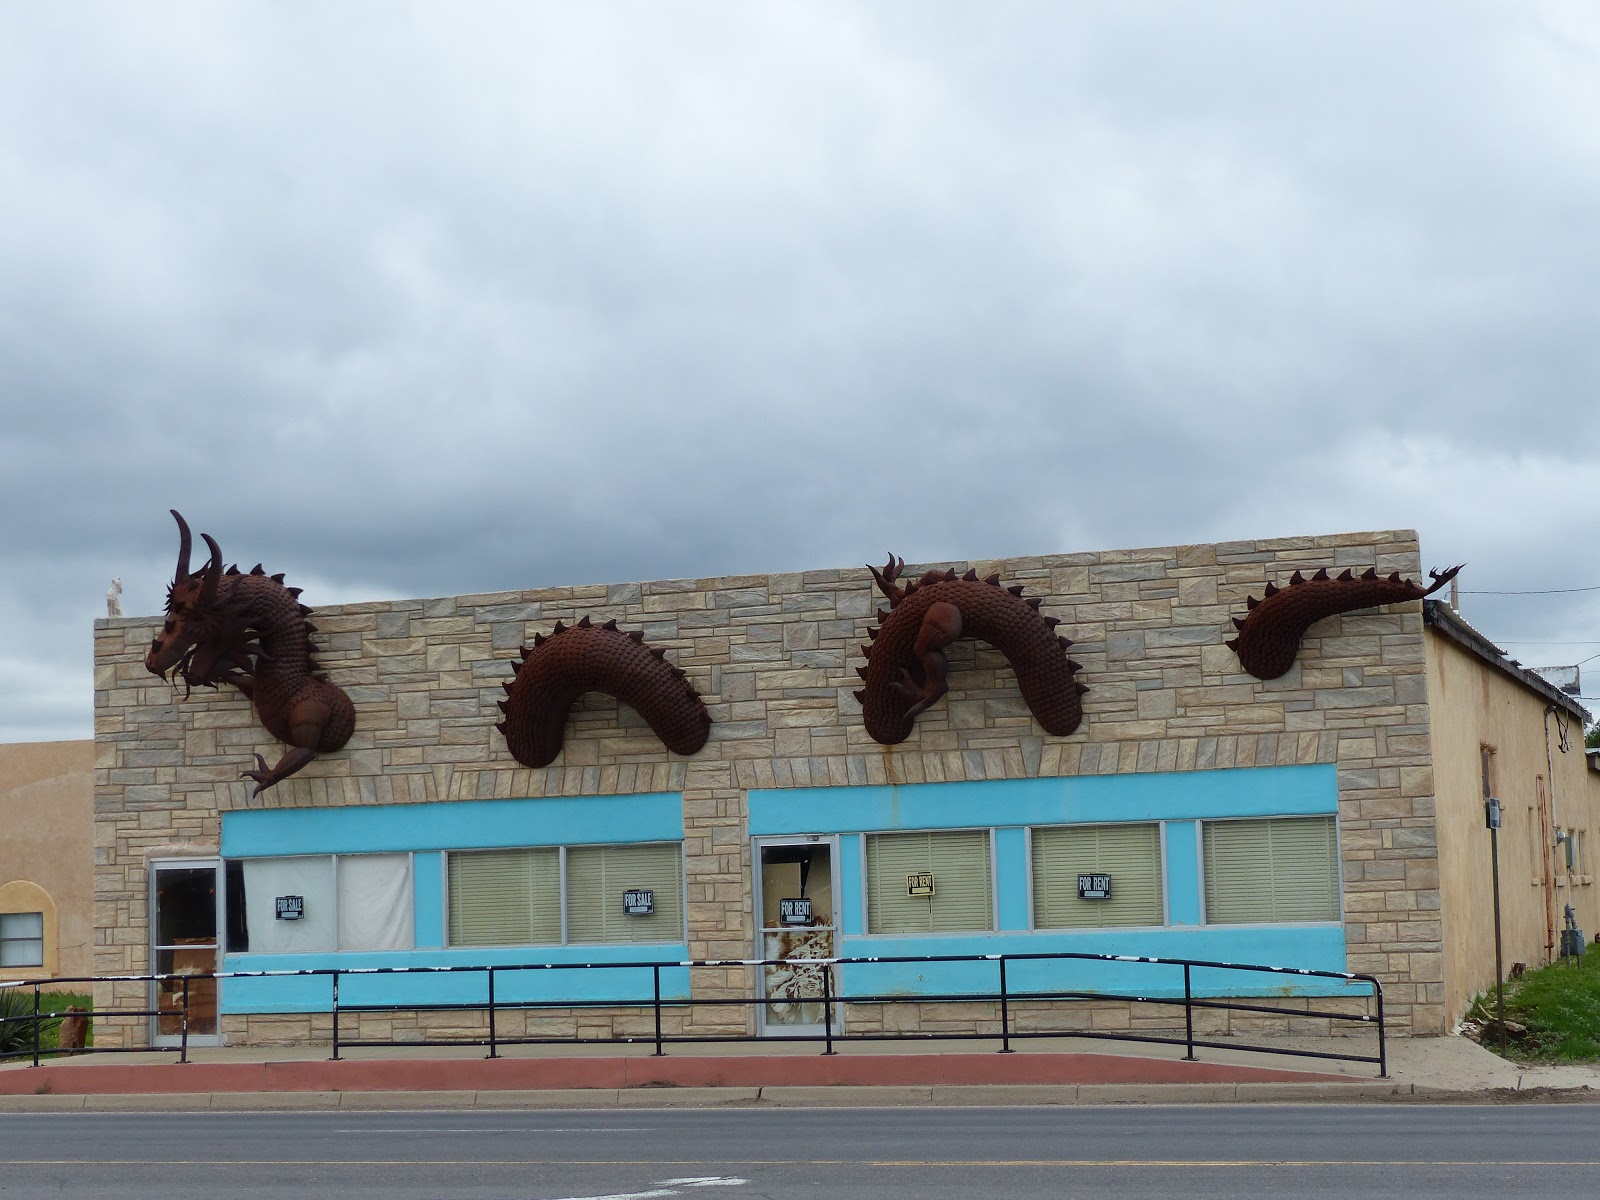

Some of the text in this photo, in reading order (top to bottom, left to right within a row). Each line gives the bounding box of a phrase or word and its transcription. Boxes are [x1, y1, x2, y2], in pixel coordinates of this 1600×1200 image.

[909, 876, 932, 887] FOR RENT
[1080, 877, 1109, 890] FOR RENT
[278, 899, 301, 911] FOR SALE
[625, 893, 651, 906] FOR SALE
[781, 902, 809, 915] FOR RENT
